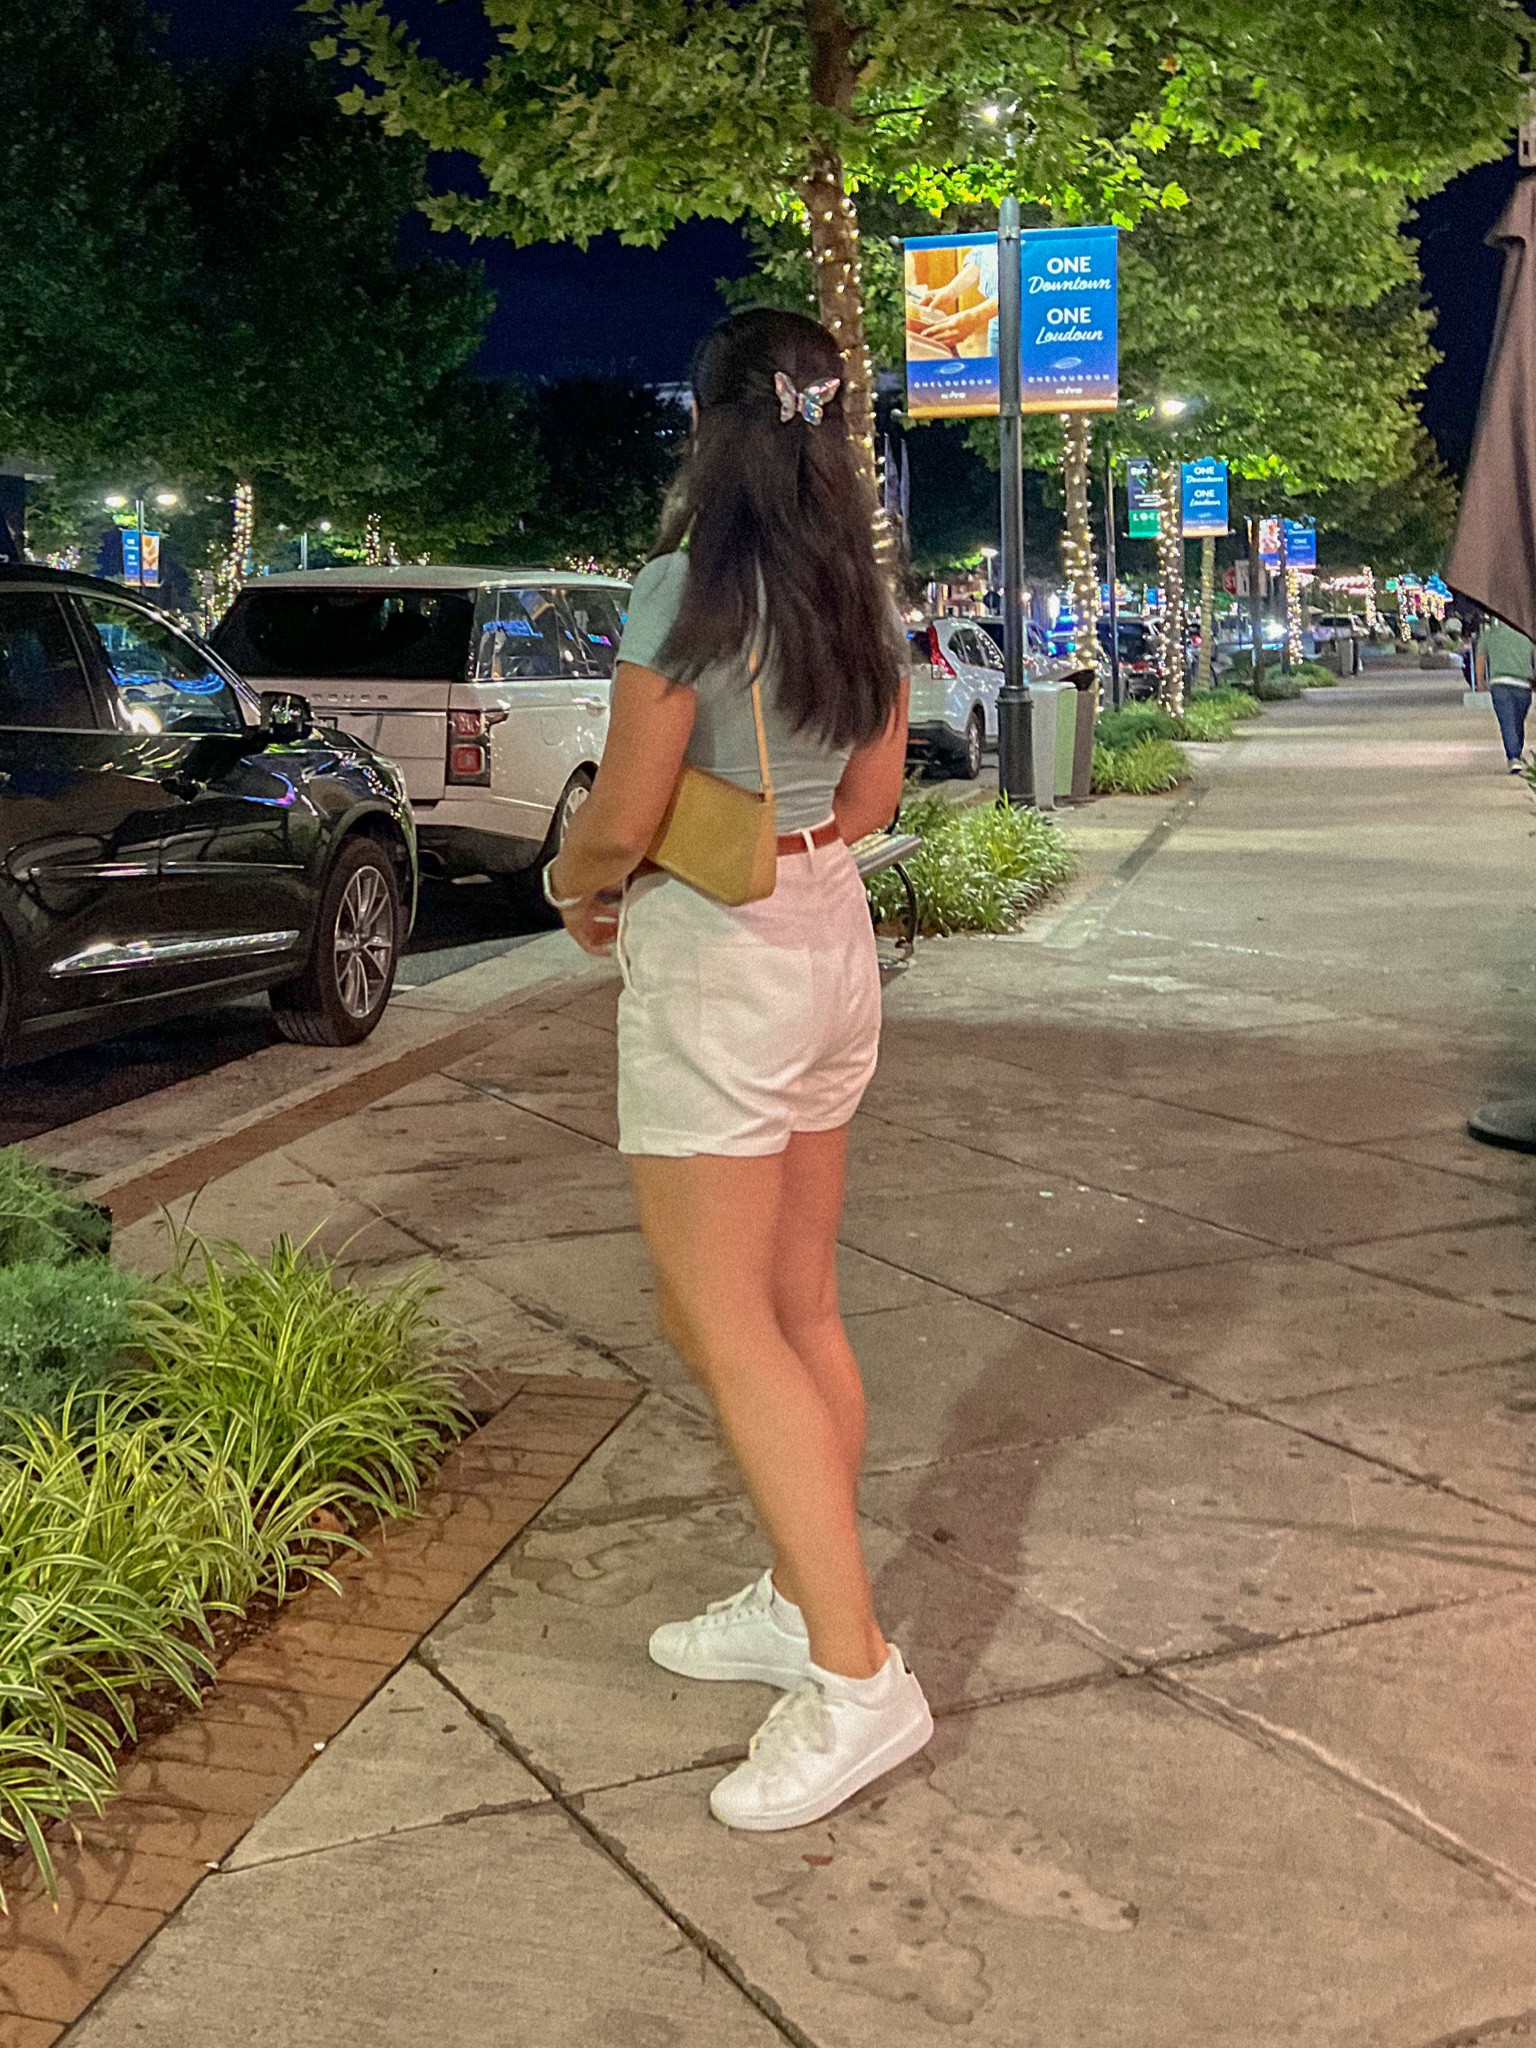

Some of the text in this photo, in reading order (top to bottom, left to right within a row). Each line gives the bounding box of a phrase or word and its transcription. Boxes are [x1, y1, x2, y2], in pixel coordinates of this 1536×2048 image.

[1046, 256, 1092, 274] ONE
[1028, 275, 1111, 294] Downtown
[1046, 307, 1092, 325] ONE
[1035, 326, 1103, 345] Loudoun
[1193, 466, 1215, 475] ONE
[1193, 489, 1215, 498] ONE
